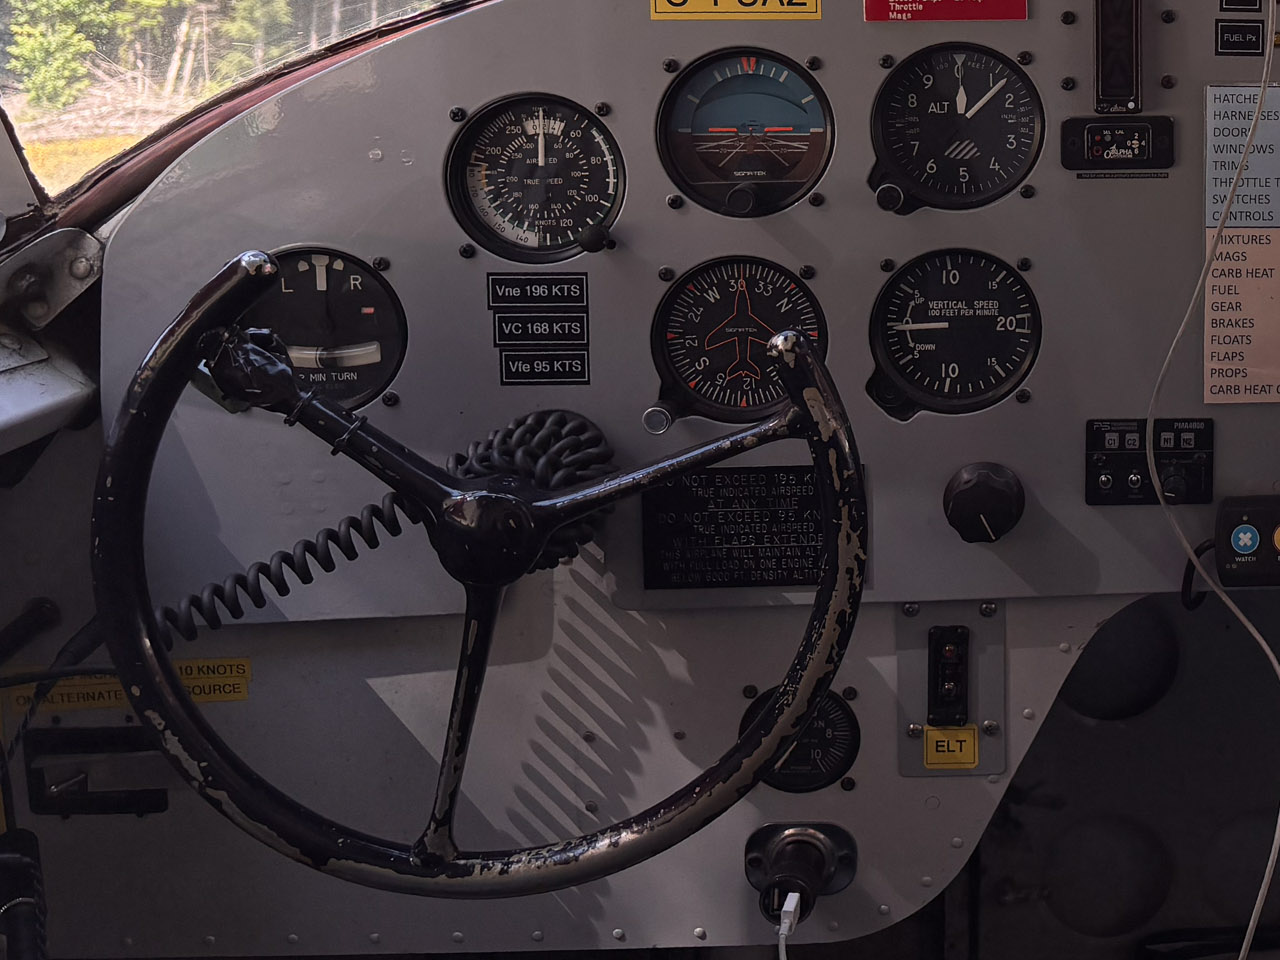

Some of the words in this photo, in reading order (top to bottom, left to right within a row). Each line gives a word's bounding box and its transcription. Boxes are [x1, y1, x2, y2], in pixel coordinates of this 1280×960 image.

[923, 75, 934, 89] 9
[908, 93, 917, 108] 8
[1005, 93, 1014, 108] 2
[1213, 94, 1260, 104] HATCHE
[928, 102, 950, 113] ALT
[1213, 111, 1280, 121] HARNESES
[1213, 127, 1249, 137] DOOR
[1007, 135, 1017, 149] 3
[910, 141, 919, 156] 7
[590, 156, 602, 165] 80
[926, 159, 937, 173] 6
[990, 157, 1000, 171] 4
[959, 168, 969, 182] 5
[585, 194, 599, 202] 100
[1213, 194, 1271, 205] SWTCHES
[1212, 211, 1274, 222] CNTROLS
[560, 218, 573, 227] 120
[1213, 252, 1247, 262] MAGS
[942, 270, 959, 285] 10
[1211, 268, 1242, 278] CARB
[1246, 269, 1275, 279] HEAT
[281, 277, 294, 293] L
[350, 275, 363, 290] R
[496, 285, 520, 296] Vne
[525, 285, 548, 296] 196
[552, 285, 580, 296] KTS
[755, 281, 773, 296] 33
[1211, 285, 1239, 295] FUEL
[703, 287, 720, 303] W
[776, 298, 792, 313] N
[929, 301, 967, 309] VERTICAL
[1211, 302, 1242, 312] GEAR
[502, 323, 522, 334] VC
[527, 323, 549, 334] 168
[553, 323, 581, 334] KTS
[996, 317, 1016, 330] 20
[1211, 318, 1255, 328] BRAKES
[1211, 335, 1252, 345] FLOATS
[1210, 352, 1245, 361] FLAPS
[509, 361, 530, 372] Vfe
[534, 361, 550, 372] 95
[554, 360, 581, 372] KTS
[695, 357, 709, 370] S
[942, 363, 959, 377] 10
[1210, 368, 1248, 378] PROPS
[310, 374, 326, 382] MIN
[331, 372, 358, 381] TURN
[1210, 385, 1241, 394] CARB
[1244, 385, 1273, 394] HEAT
[682, 475, 709, 486] NOT
[715, 474, 767, 485] EXCEED
[774, 473, 796, 484] 195
[692, 488, 715, 497] TRUE
[720, 487, 767, 497] INDICATED
[771, 486, 815, 496] AIRSPEED
[707, 499, 725, 509] AT
[732, 499, 759, 508] ANY
[767, 498, 799, 509] TIME
[684, 512, 709, 522] NOT
[718, 511, 770, 522] EXCEED
[778, 510, 796, 521] 95
[693, 526, 715, 534] TRUE
[721, 525, 768, 534] INDICATED
[772, 524, 815, 533] AIRSPEED
[715, 536, 756, 546] FLAPS
[732, 548, 754, 558] WILL
[758, 547, 801, 556] MAINTAIN
[760, 559, 777, 568] ONE
[782, 558, 814, 568] ENGINE
[751, 570, 788, 580] DENSITY
[197, 664, 246, 675] KNOTS
[42, 690, 122, 704] ALTERNATE
[935, 740, 967, 753] ELT
